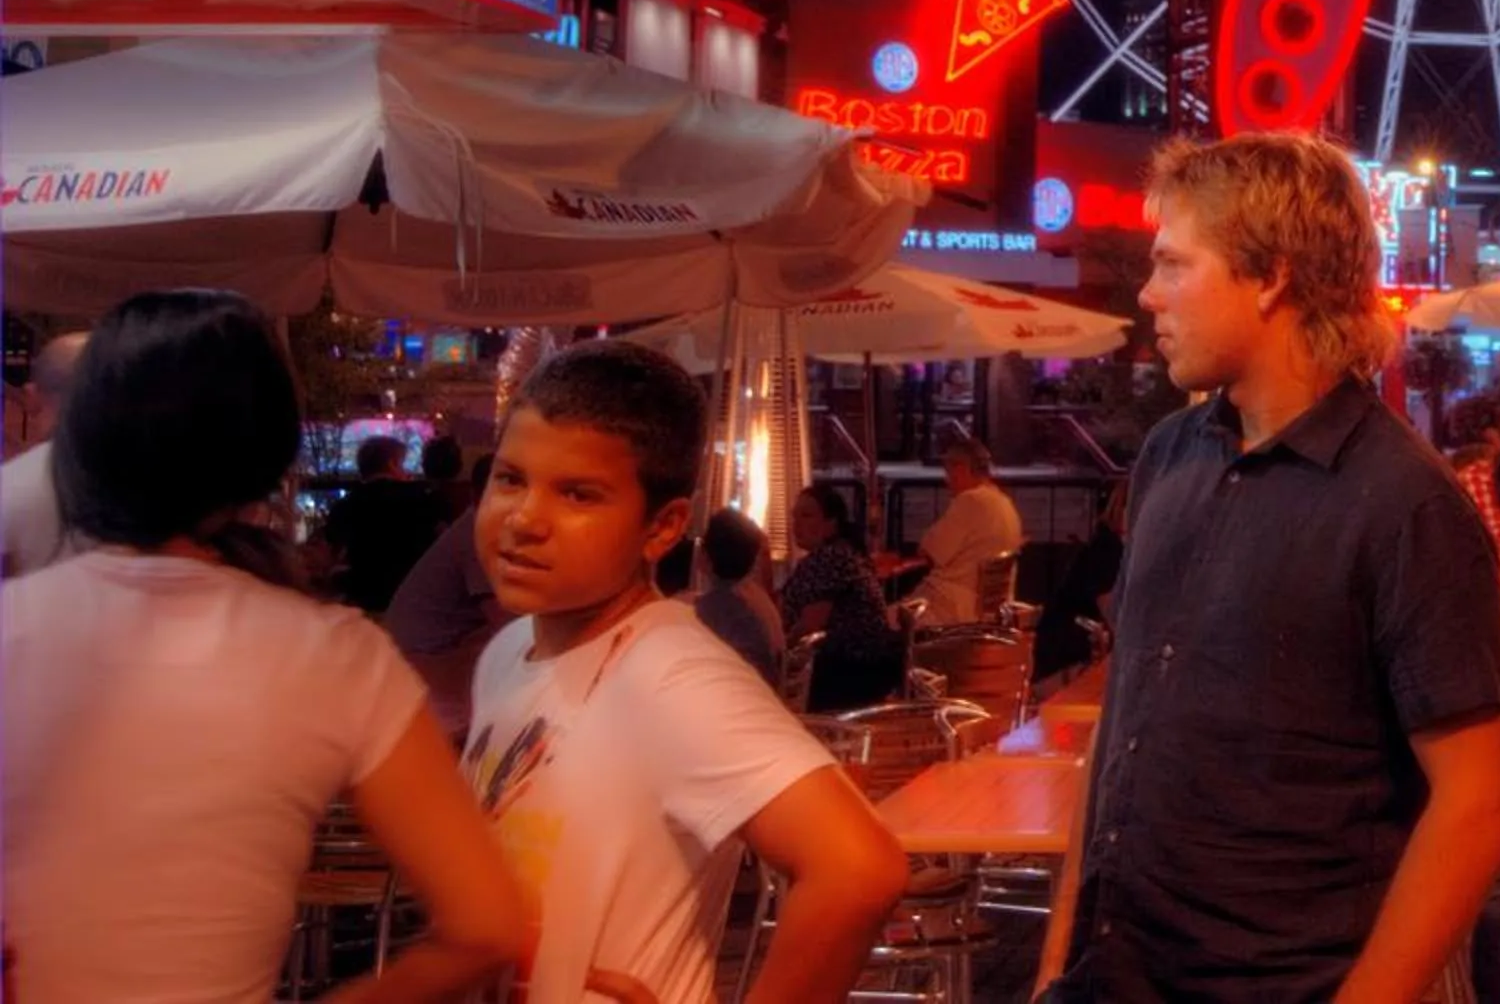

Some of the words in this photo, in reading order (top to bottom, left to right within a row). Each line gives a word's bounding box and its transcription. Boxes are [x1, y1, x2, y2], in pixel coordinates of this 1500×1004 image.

[18, 168, 170, 204] CANADIAN
[936, 231, 1000, 251] SPORTS
[1002, 233, 1036, 252] BAR
